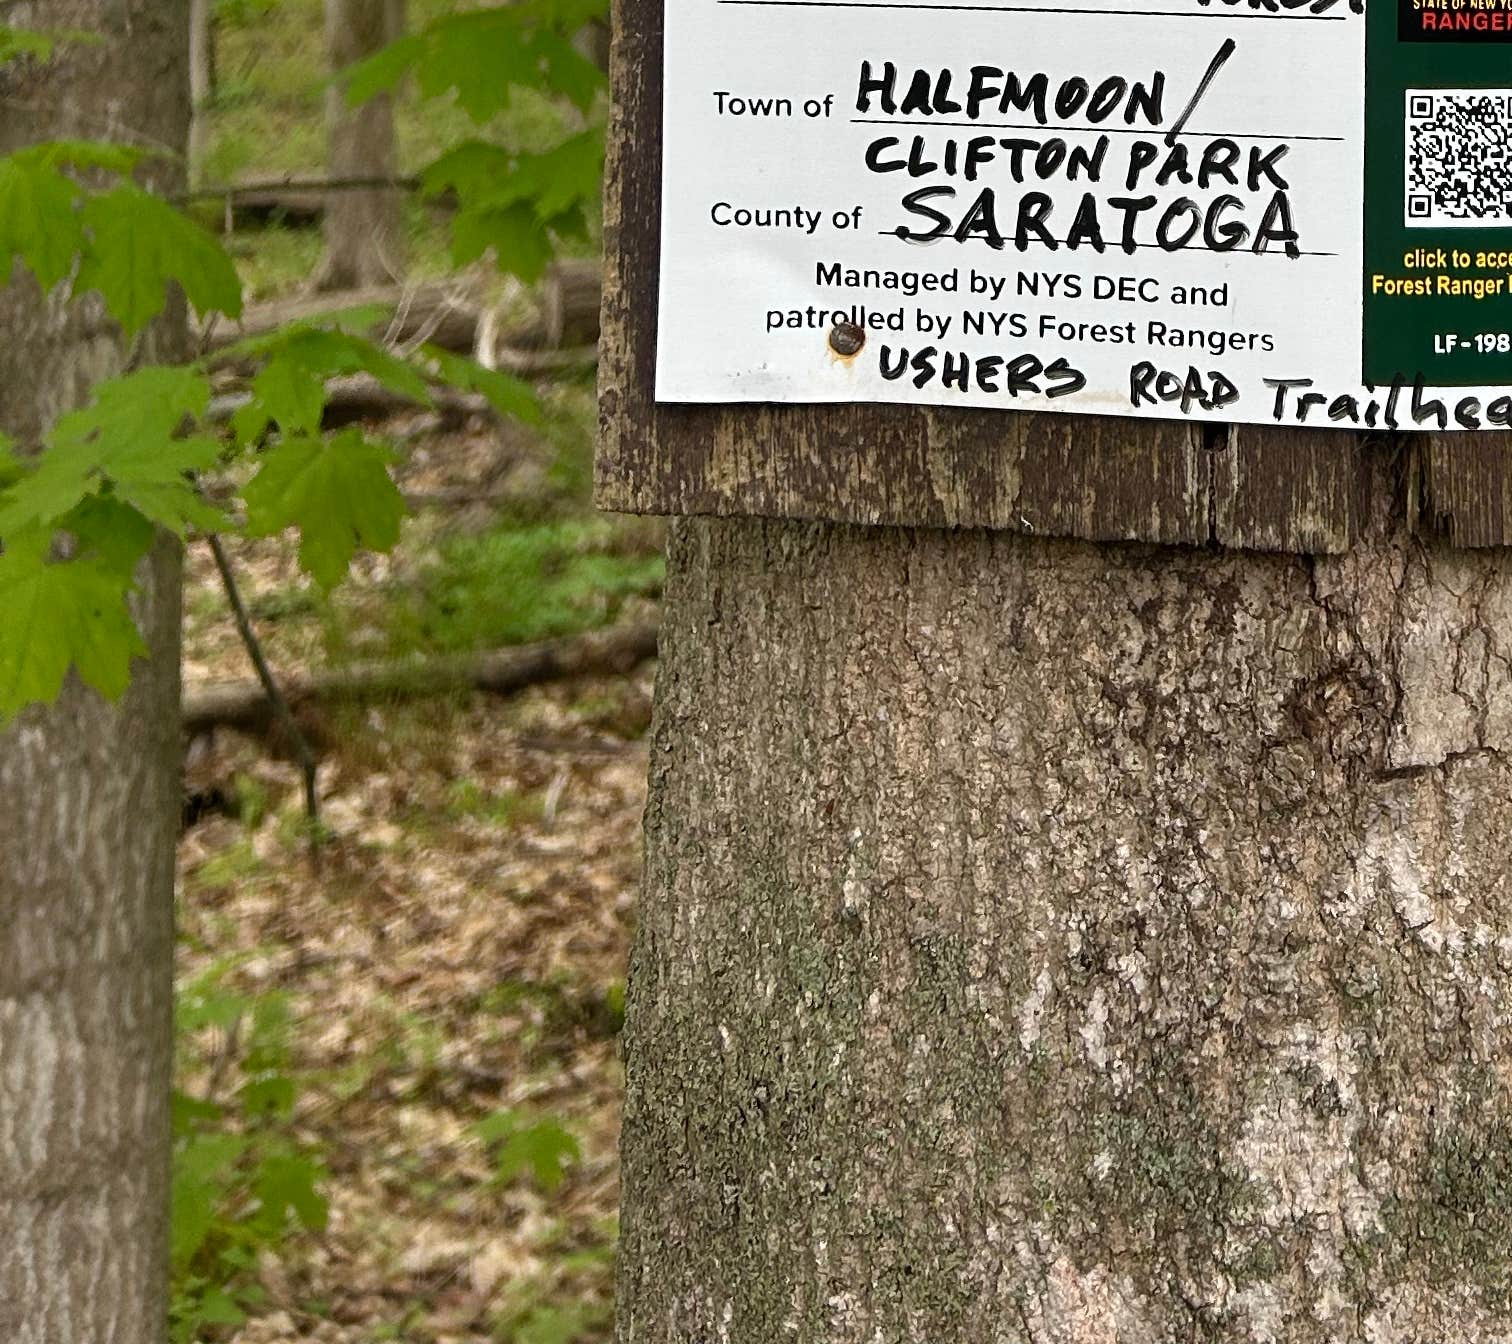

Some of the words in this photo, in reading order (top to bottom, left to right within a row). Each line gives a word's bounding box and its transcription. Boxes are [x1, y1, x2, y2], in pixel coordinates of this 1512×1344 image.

[712, 91, 792, 117] Town
[803, 94, 835, 118] of
[864, 134, 1110, 184] CLIFTON
[1125, 140, 1293, 193] PARK
[710, 202, 822, 235] County
[832, 205, 864, 230] of
[894, 183, 1302, 260] SARATOGA
[1403, 248, 1447, 268] click
[1451, 249, 1471, 268] to
[816, 262, 959, 297] Managed
[970, 268, 1007, 301] by
[1016, 271, 1082, 299] NYS
[1093, 275, 1160, 303] DEC
[1170, 282, 1228, 307] and
[1372, 274, 1432, 295] Forest
[1437, 275, 1505, 300] Ranger
[766, 306, 906, 336] patrolled
[916, 308, 952, 340] by
[963, 310, 1028, 338] NYS
[1039, 314, 1136, 344] Forest
[1147, 320, 1274, 356] Rangers
[879, 346, 1089, 400] USHERS
[1130, 360, 1240, 412] ROAD
